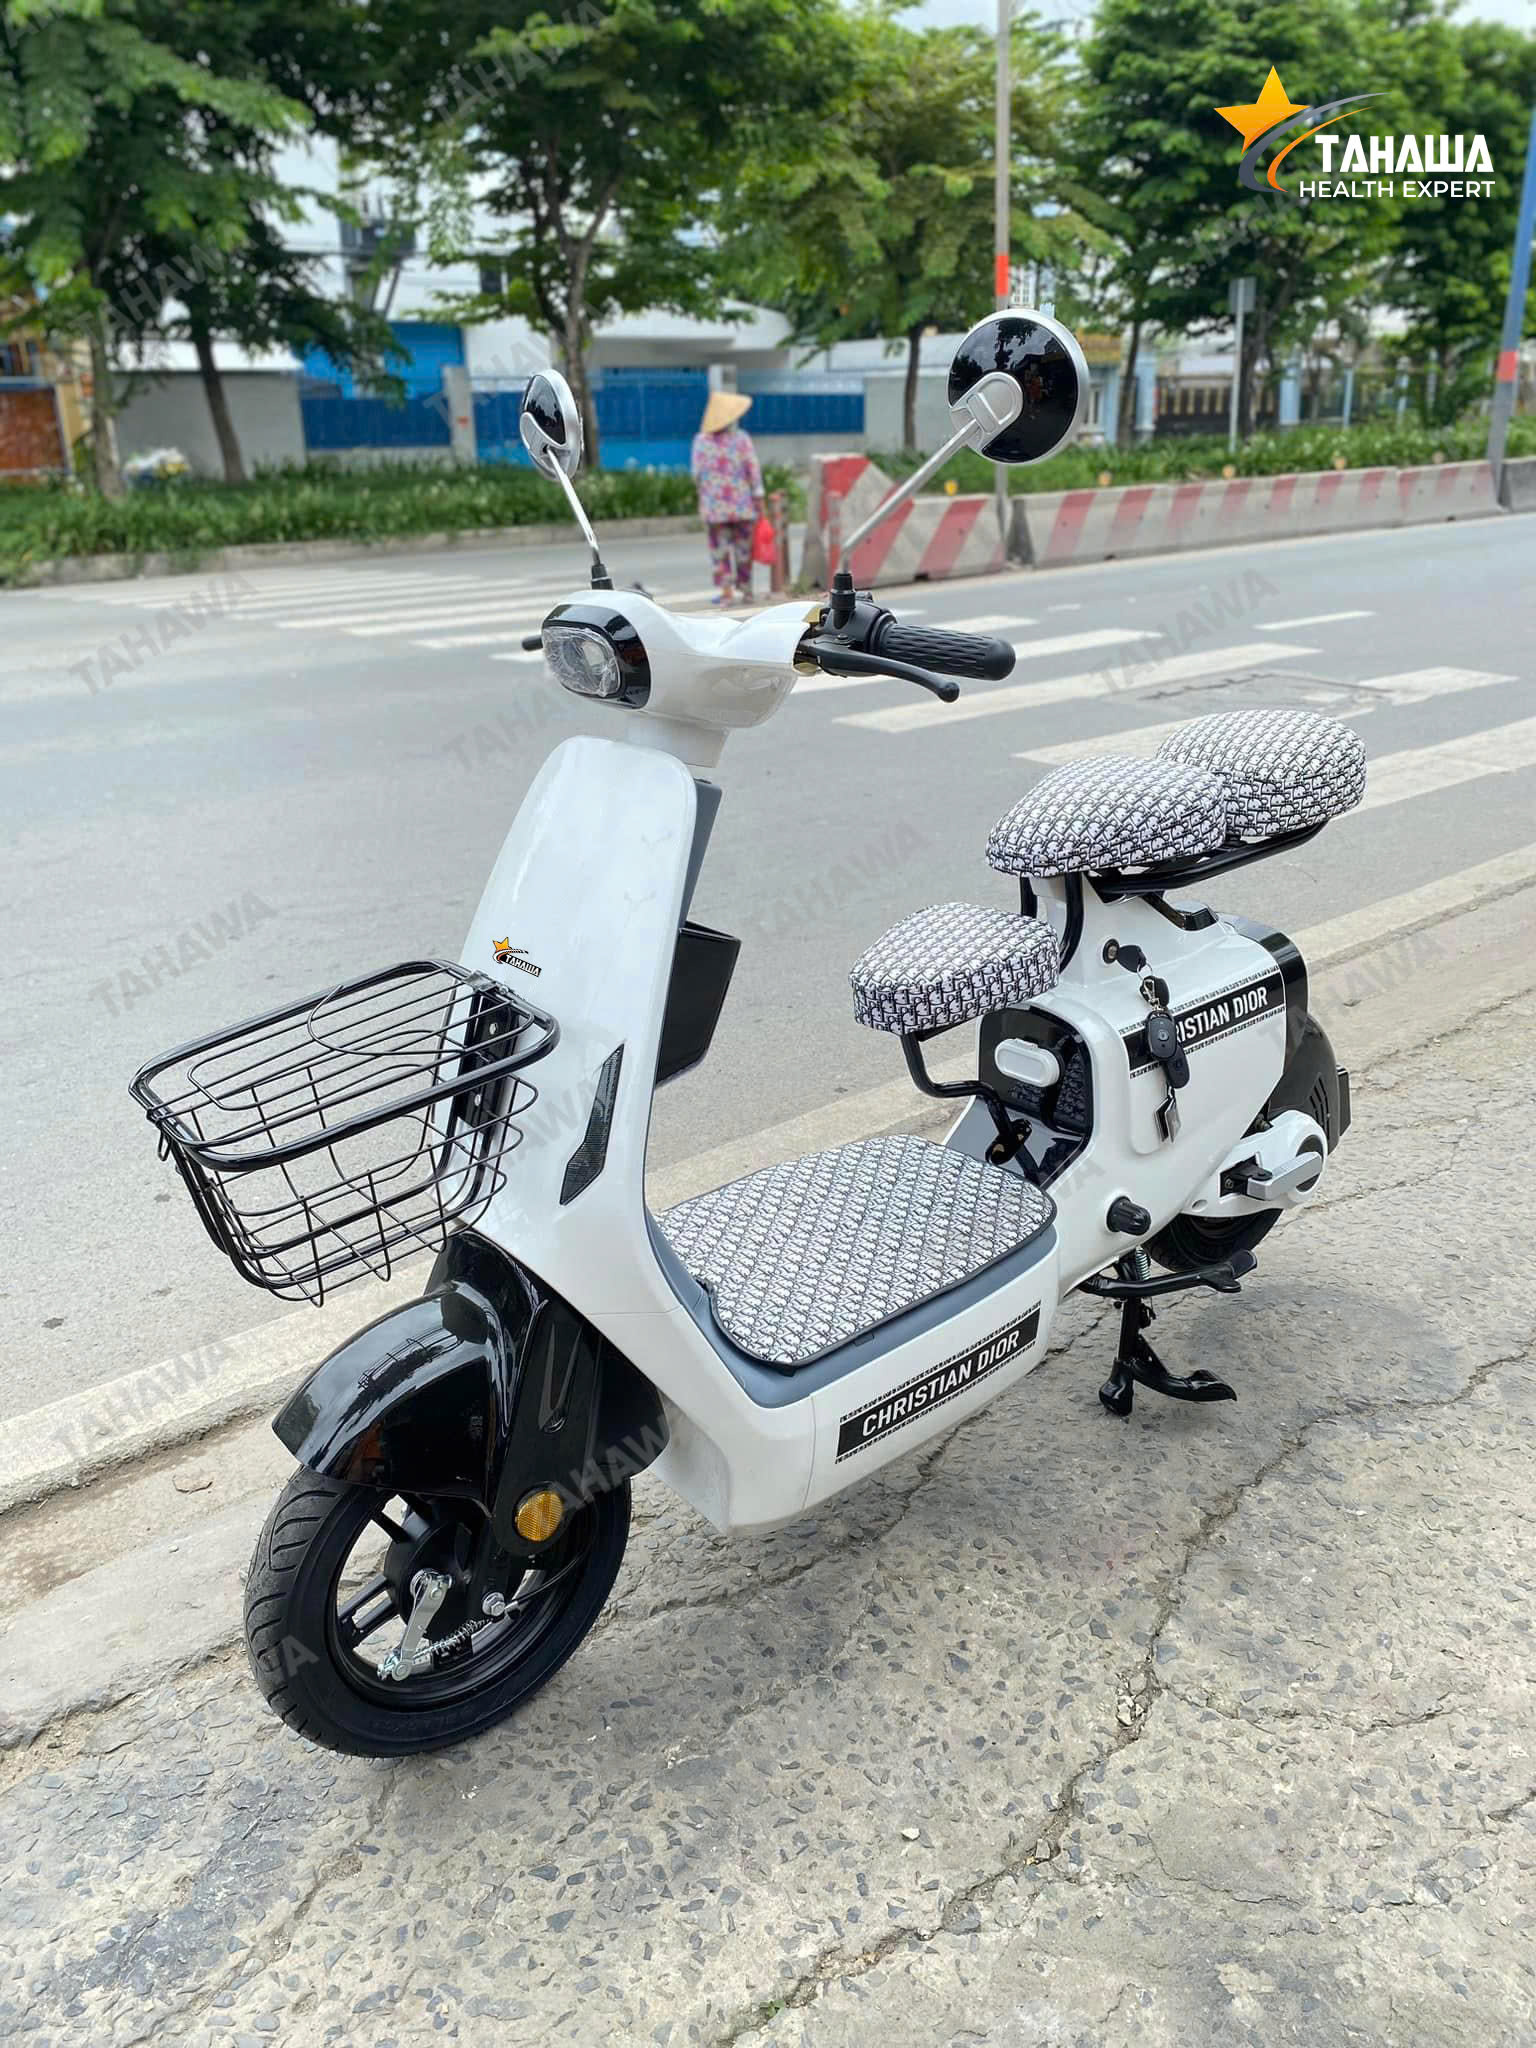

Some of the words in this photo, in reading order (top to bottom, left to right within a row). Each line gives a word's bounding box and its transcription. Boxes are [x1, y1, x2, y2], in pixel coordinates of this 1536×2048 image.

[1175, 1001, 1230, 1043] RISTIAN
[1233, 986, 1268, 1017] DIOR
[862, 1359, 972, 1437] CHRISTIAN
[977, 1330, 1020, 1372] DIOR
